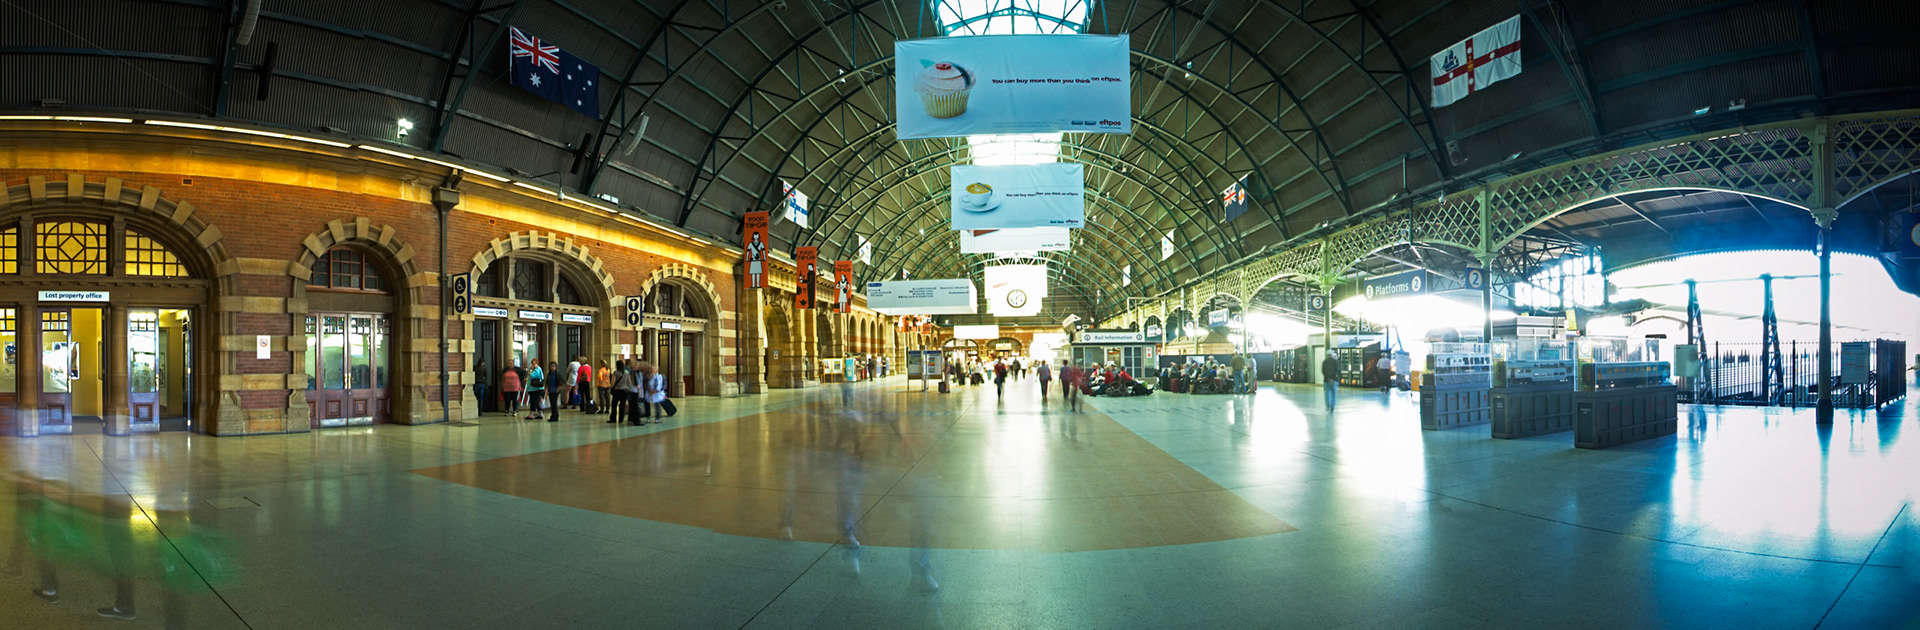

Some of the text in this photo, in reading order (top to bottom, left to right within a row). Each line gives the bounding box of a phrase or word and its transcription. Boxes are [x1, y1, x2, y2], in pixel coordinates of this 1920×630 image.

[1099, 118, 1121, 127] eftpos
[1472, 272, 1479, 285] 2
[1375, 282, 1409, 296] Platforms
